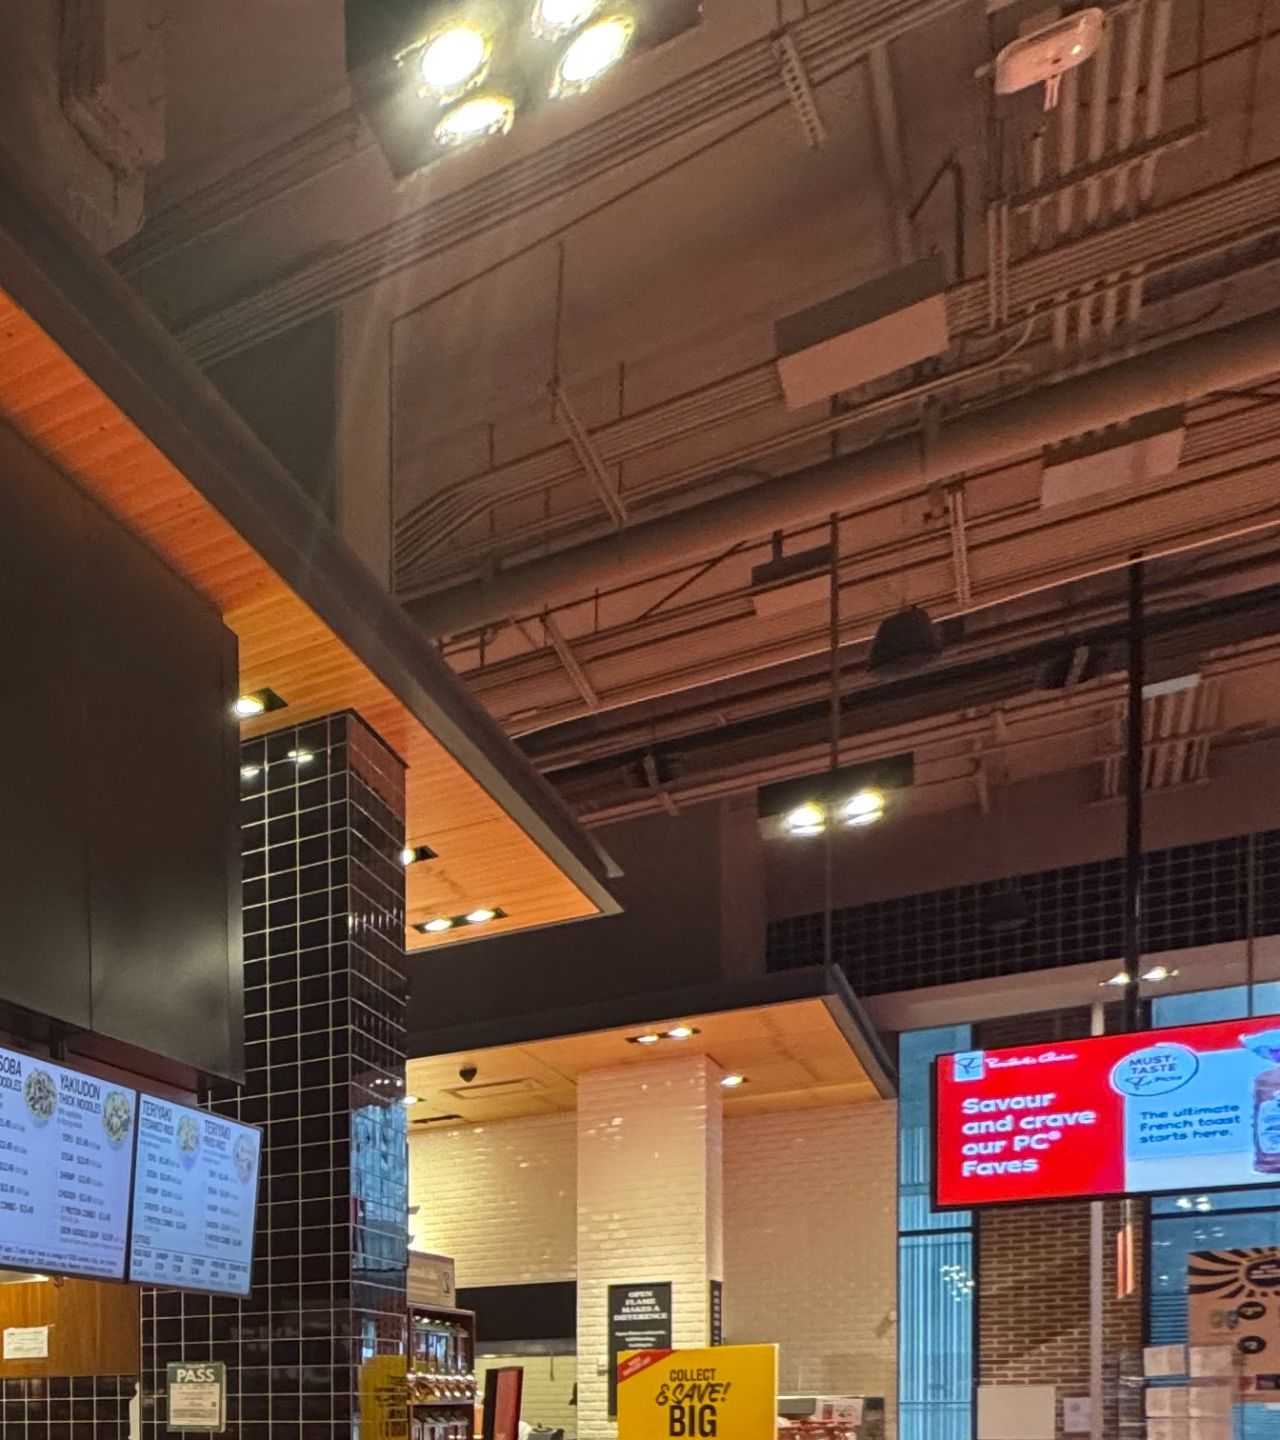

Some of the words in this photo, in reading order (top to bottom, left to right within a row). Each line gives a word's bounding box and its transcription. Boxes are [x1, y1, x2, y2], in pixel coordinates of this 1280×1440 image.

[1129, 1054, 1178, 1067] MUST-
[1130, 1064, 1178, 1075] TASTE
[59, 1073, 101, 1101] YAKIUDON
[76, 1097, 101, 1115] NOODLES
[961, 1092, 1057, 1114] Savour
[1140, 1109, 1168, 1120] The
[1173, 1104, 1240, 1118] ultimate
[961, 1115, 1013, 1136] and
[1019, 1110, 1097, 1130] crave
[1139, 1120, 1194, 1132] French
[1198, 1113, 1241, 1127] toast
[1139, 1132, 1188, 1143] starts
[961, 1139, 1006, 1156] our
[961, 1158, 1039, 1177] Faves
[614, 1312, 668, 1321] DIFFERENCE
[177, 1369, 216, 1383] PASS
[669, 1368, 717, 1382] COLLECT
[669, 1404, 717, 1438] BIG
